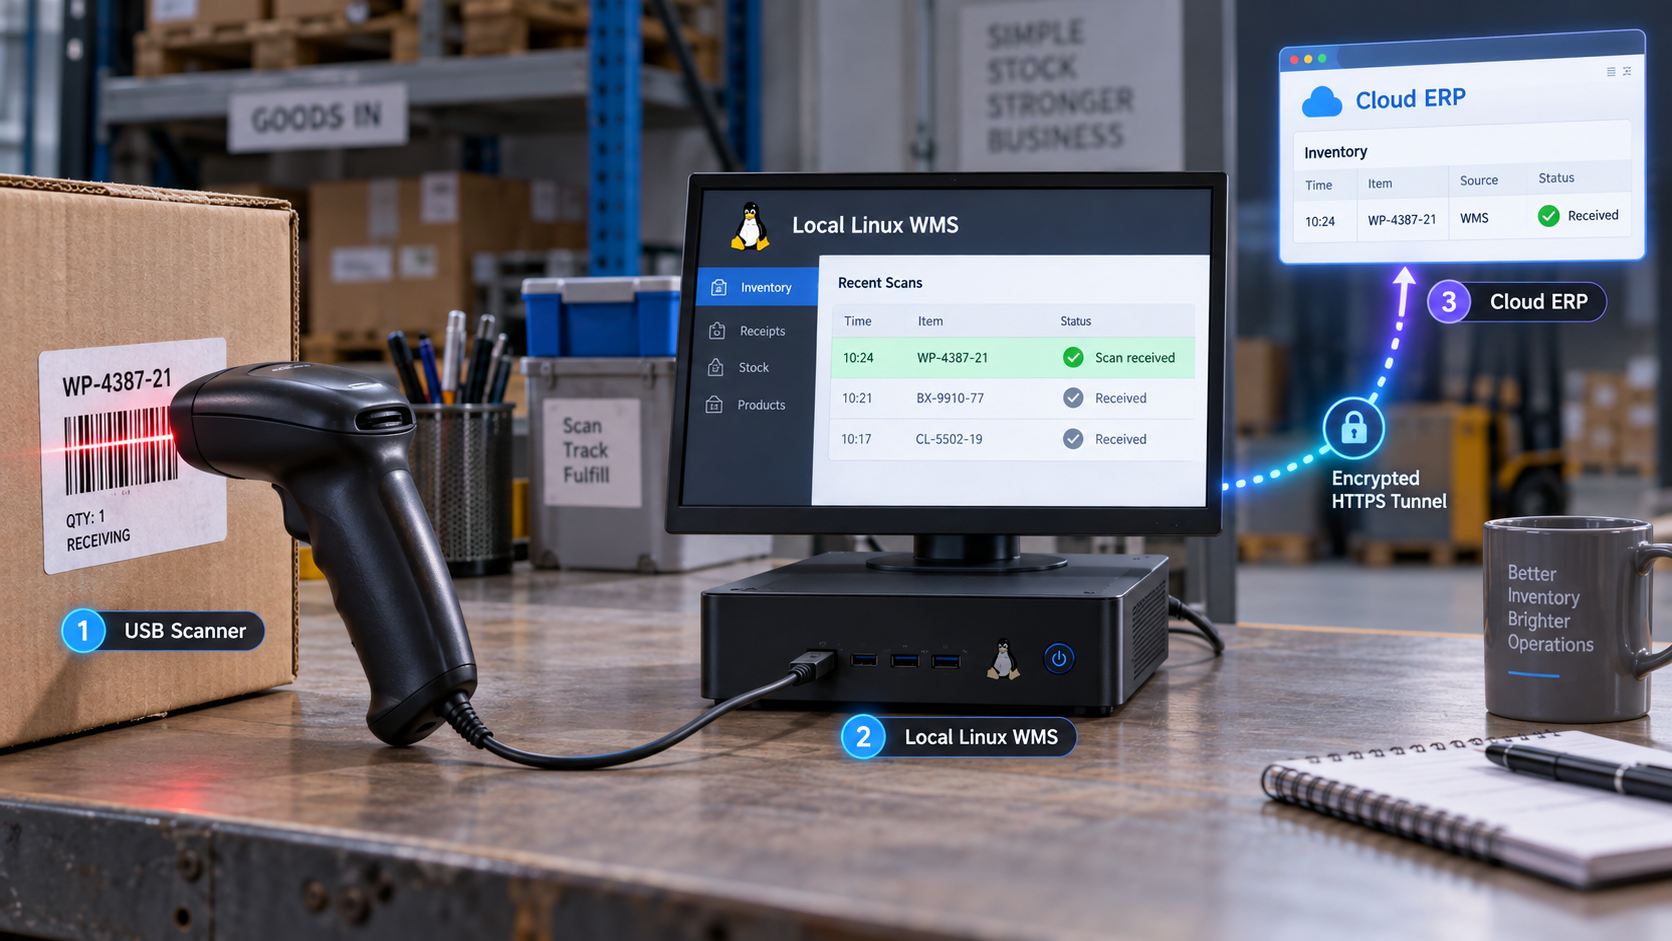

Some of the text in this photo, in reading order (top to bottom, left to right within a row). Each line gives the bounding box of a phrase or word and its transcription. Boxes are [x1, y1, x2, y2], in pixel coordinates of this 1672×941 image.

[987, 18, 1085, 50] SIMPLE
[987, 53, 1077, 85] STOCK
[987, 86, 1134, 120] STRONGER
[1357, 88, 1466, 109] Cloud ERP
[252, 100, 381, 134] GOODS IN
[987, 121, 1124, 154] BUSINESS
[1305, 146, 1367, 160] Inventory
[1306, 173, 1574, 190] Time Item Source Status
[794, 216, 958, 233] Local Linux WMS
[1306, 209, 1618, 227] 10:24 WP-4387-21 WMS Received
[742, 283, 792, 295] Inventory
[839, 277, 922, 288] Recent Scans
[845, 316, 1091, 326] Time Item Status
[741, 326, 785, 338] Receipts
[844, 352, 1175, 363] 10:24 WP-4387-21 Scan received
[739, 362, 769, 372] Stock
[63, 368, 171, 396] WP-4387-21
[738, 400, 785, 410] Products
[843, 393, 1146, 403] 10:21 BX-9910-77 Received
[563, 417, 602, 434] Scan
[842, 434, 1146, 444] 10:17 CL-5502-19 Received
[563, 442, 608, 458] Track
[564, 466, 609, 483] Fulfill
[67, 509, 104, 528] QTY: 1
[68, 529, 130, 551] RECEIVING
[1509, 564, 1557, 581] Better
[1509, 587, 1580, 609] Inventory
[1509, 611, 1570, 631] Brighter
[1508, 634, 1593, 654] Operations
